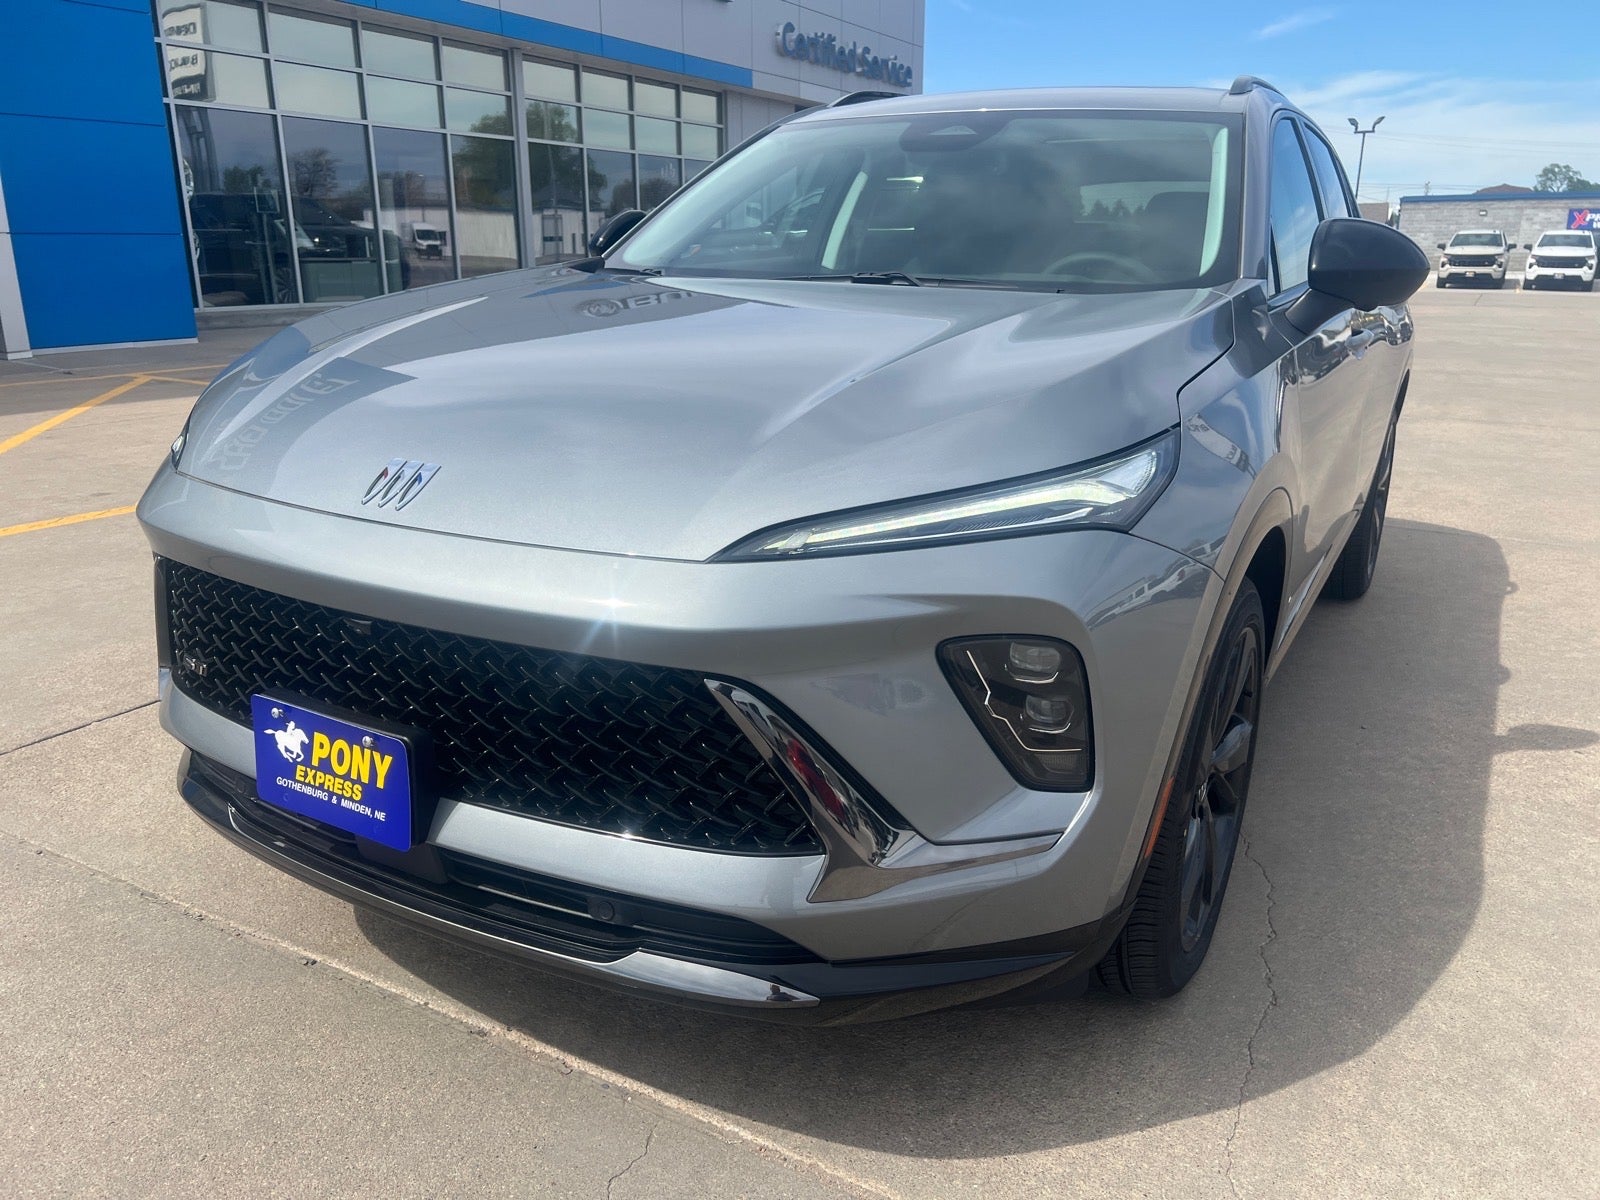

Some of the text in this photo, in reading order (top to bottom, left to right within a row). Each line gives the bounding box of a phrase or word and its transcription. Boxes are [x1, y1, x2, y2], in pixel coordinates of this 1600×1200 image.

[776, 22, 913, 88] Certified Service
[295, 764, 363, 801] EXPRESS
[312, 731, 393, 790] PONY
[276, 776, 387, 822] GOTHENBURG & MINDEN, NE
